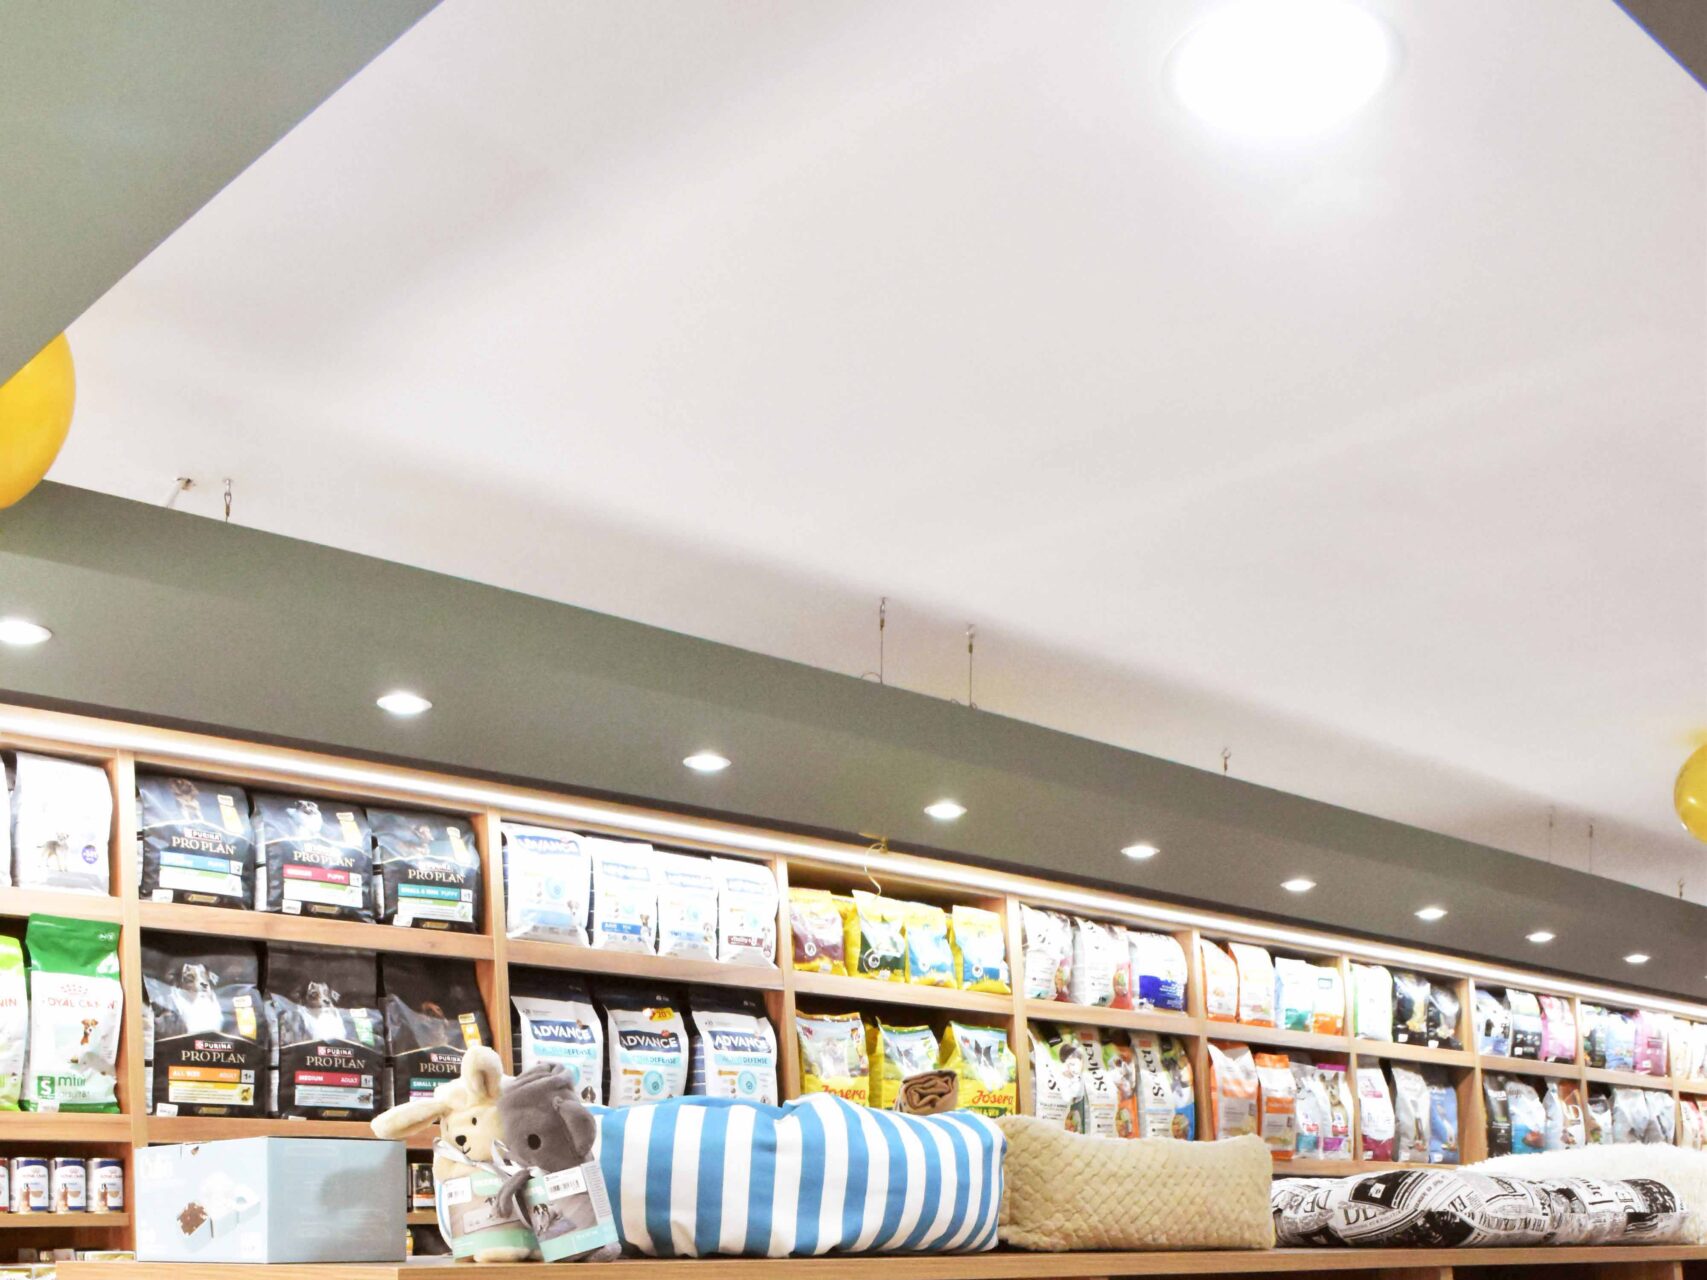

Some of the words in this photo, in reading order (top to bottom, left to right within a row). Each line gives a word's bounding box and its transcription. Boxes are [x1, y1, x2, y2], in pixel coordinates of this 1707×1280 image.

[534, 1025, 593, 1041] ADVANCE
[204, 1041, 232, 1050] PURINA
[622, 1036, 679, 1050] ADVANCE
[715, 1034, 770, 1049] ADVANCE
[181, 1050, 211, 1061] PRO
[213, 1052, 246, 1064] PLAN
[326, 1048, 352, 1056] PURINA
[306, 1056, 332, 1067] PRO
[334, 1058, 365, 1069] PLAN
[971, 1090, 1014, 1105] Josera
